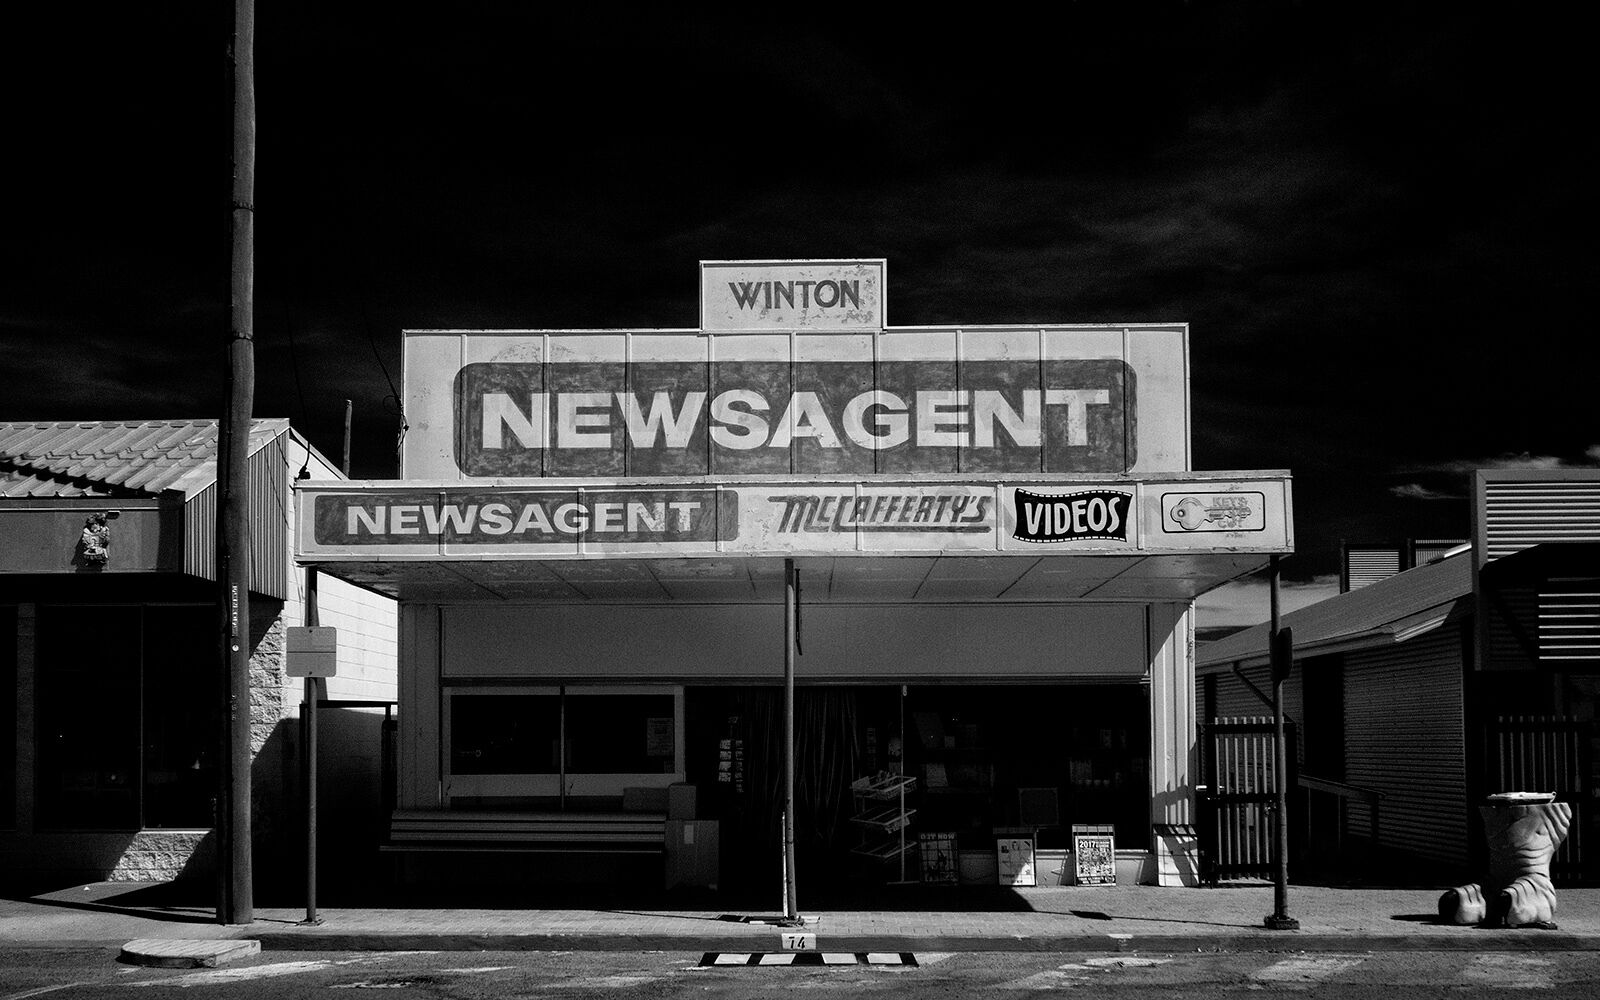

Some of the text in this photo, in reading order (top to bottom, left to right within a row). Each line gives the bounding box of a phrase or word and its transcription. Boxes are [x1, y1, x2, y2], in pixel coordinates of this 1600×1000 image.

[728, 279, 860, 311] WINTON
[482, 390, 1110, 450] NEWSAGENT
[347, 501, 702, 535] NEWSAGENT
[1024, 496, 1121, 535] VIDEOS
[1213, 496, 1248, 507] KEYS
[789, 936, 805, 949] 74
